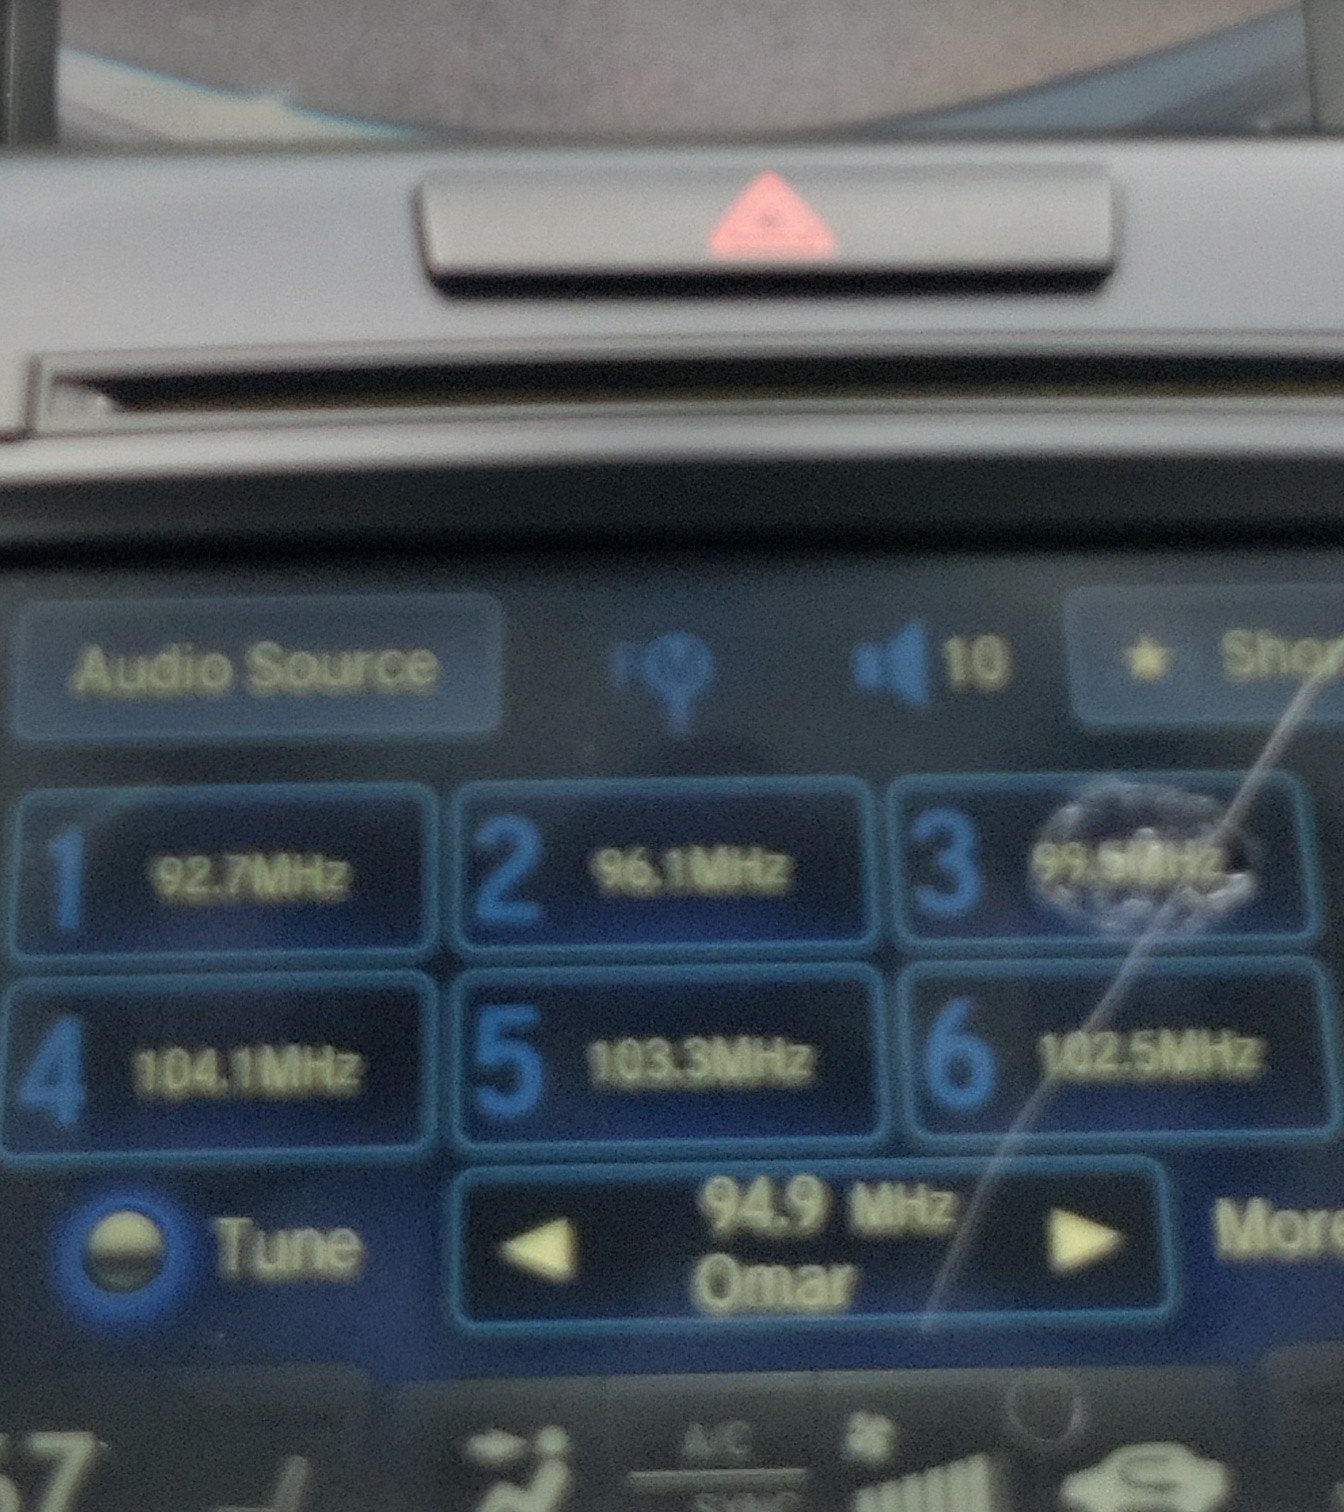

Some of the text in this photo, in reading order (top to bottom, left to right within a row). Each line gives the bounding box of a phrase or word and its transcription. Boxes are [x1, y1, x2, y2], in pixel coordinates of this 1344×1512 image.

[72, 639, 443, 699] Audio Source
[941, 632, 1013, 692] 10
[49, 824, 355, 932] 1 92.7MHz
[473, 813, 796, 926] 2 96.1MHz
[911, 806, 984, 918] 3
[15, 1013, 369, 1128] 4 104.1MHz
[475, 1004, 821, 1118] 5 103.3MHz
[924, 997, 997, 1112] 6
[211, 1216, 369, 1282] Tune
[698, 1174, 962, 1238] 94.9 MHz
[691, 1251, 858, 1317] Omar
